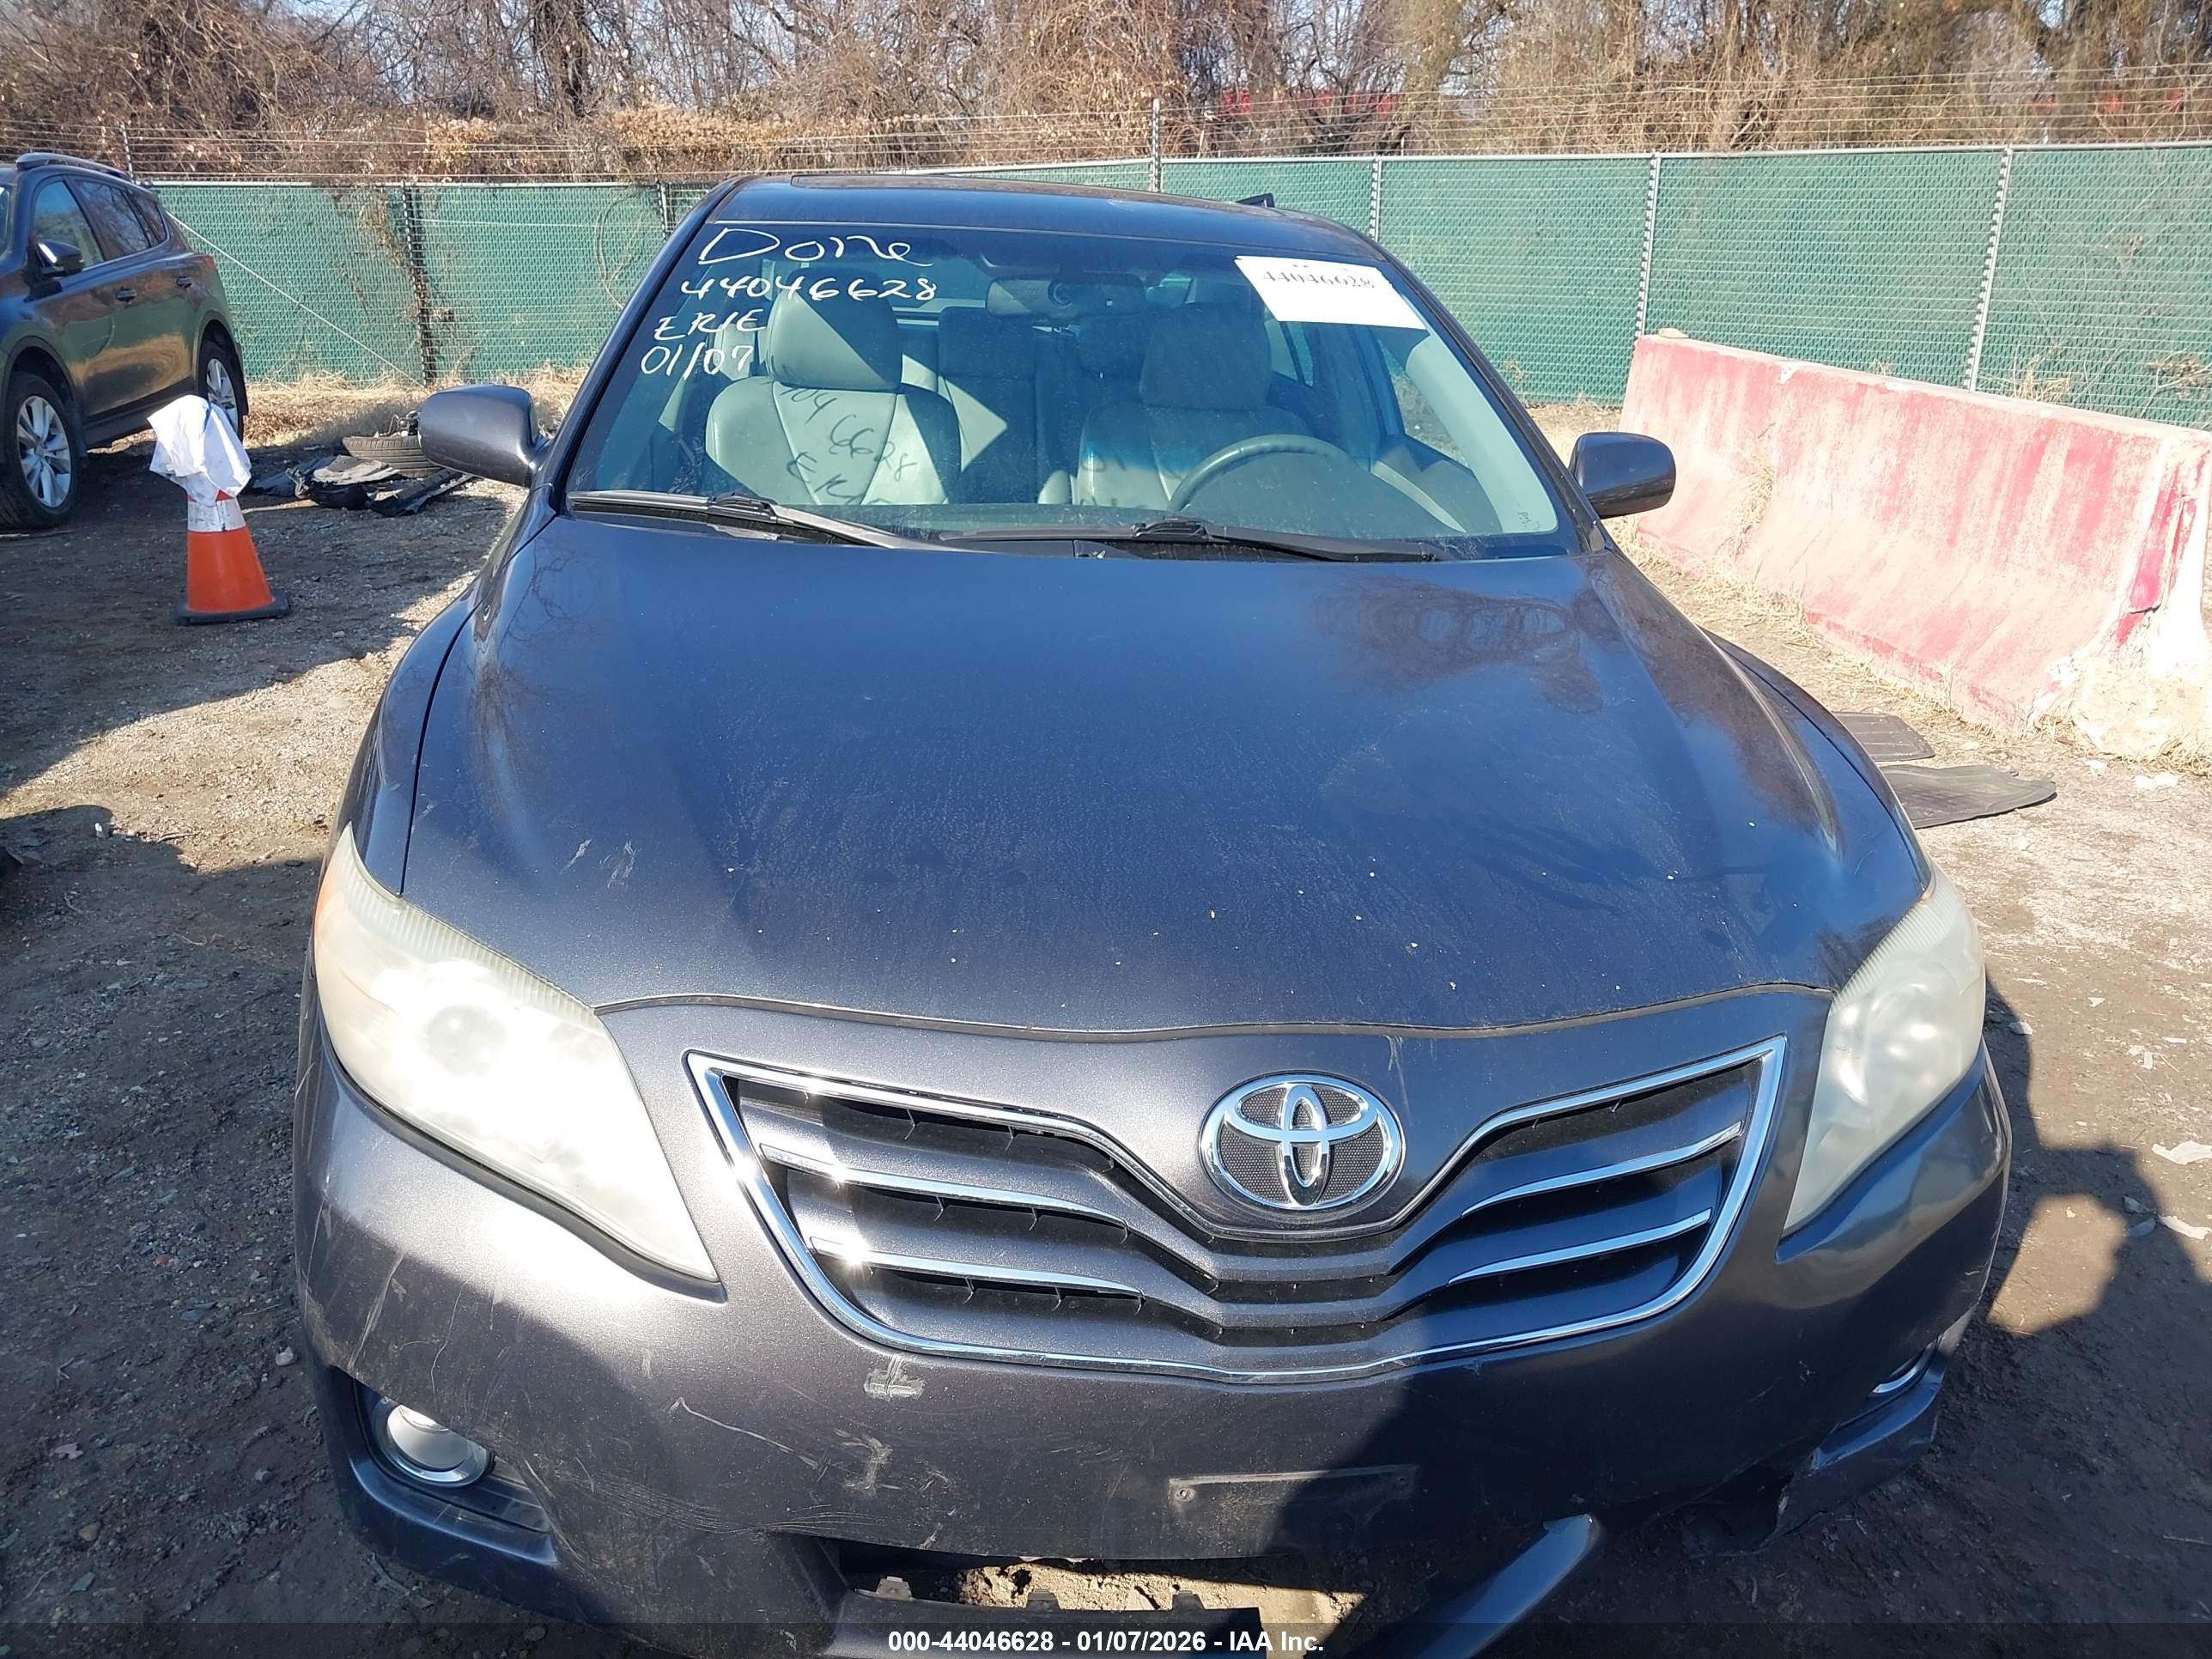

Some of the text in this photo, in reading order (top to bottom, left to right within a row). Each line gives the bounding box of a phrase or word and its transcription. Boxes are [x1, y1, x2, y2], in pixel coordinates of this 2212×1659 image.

[697, 228, 933, 267] Done
[681, 275, 938, 301] 44046628
[653, 308, 767, 341] ERIE
[641, 342, 755, 380] 01/07
